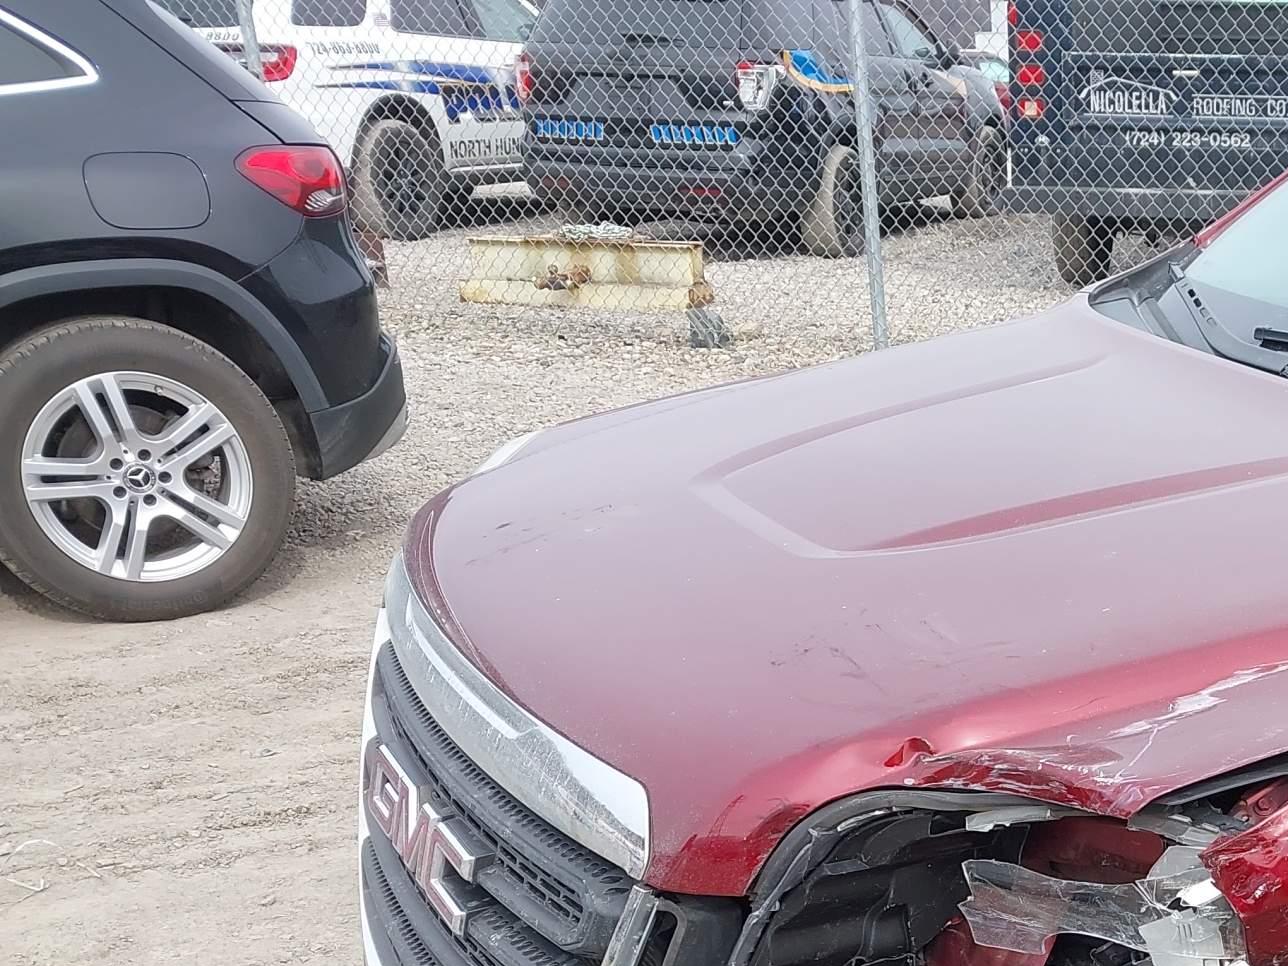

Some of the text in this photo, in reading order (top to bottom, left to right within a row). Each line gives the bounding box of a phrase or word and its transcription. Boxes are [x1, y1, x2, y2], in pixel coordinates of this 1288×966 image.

[1090, 91, 1167, 114] NICOLELLA
[1193, 98, 1256, 117] ROOFING
[449, 138, 492, 159] NORTH
[1126, 130, 1251, 148] (724) 223-0562
[368, 744, 476, 937] GMC
